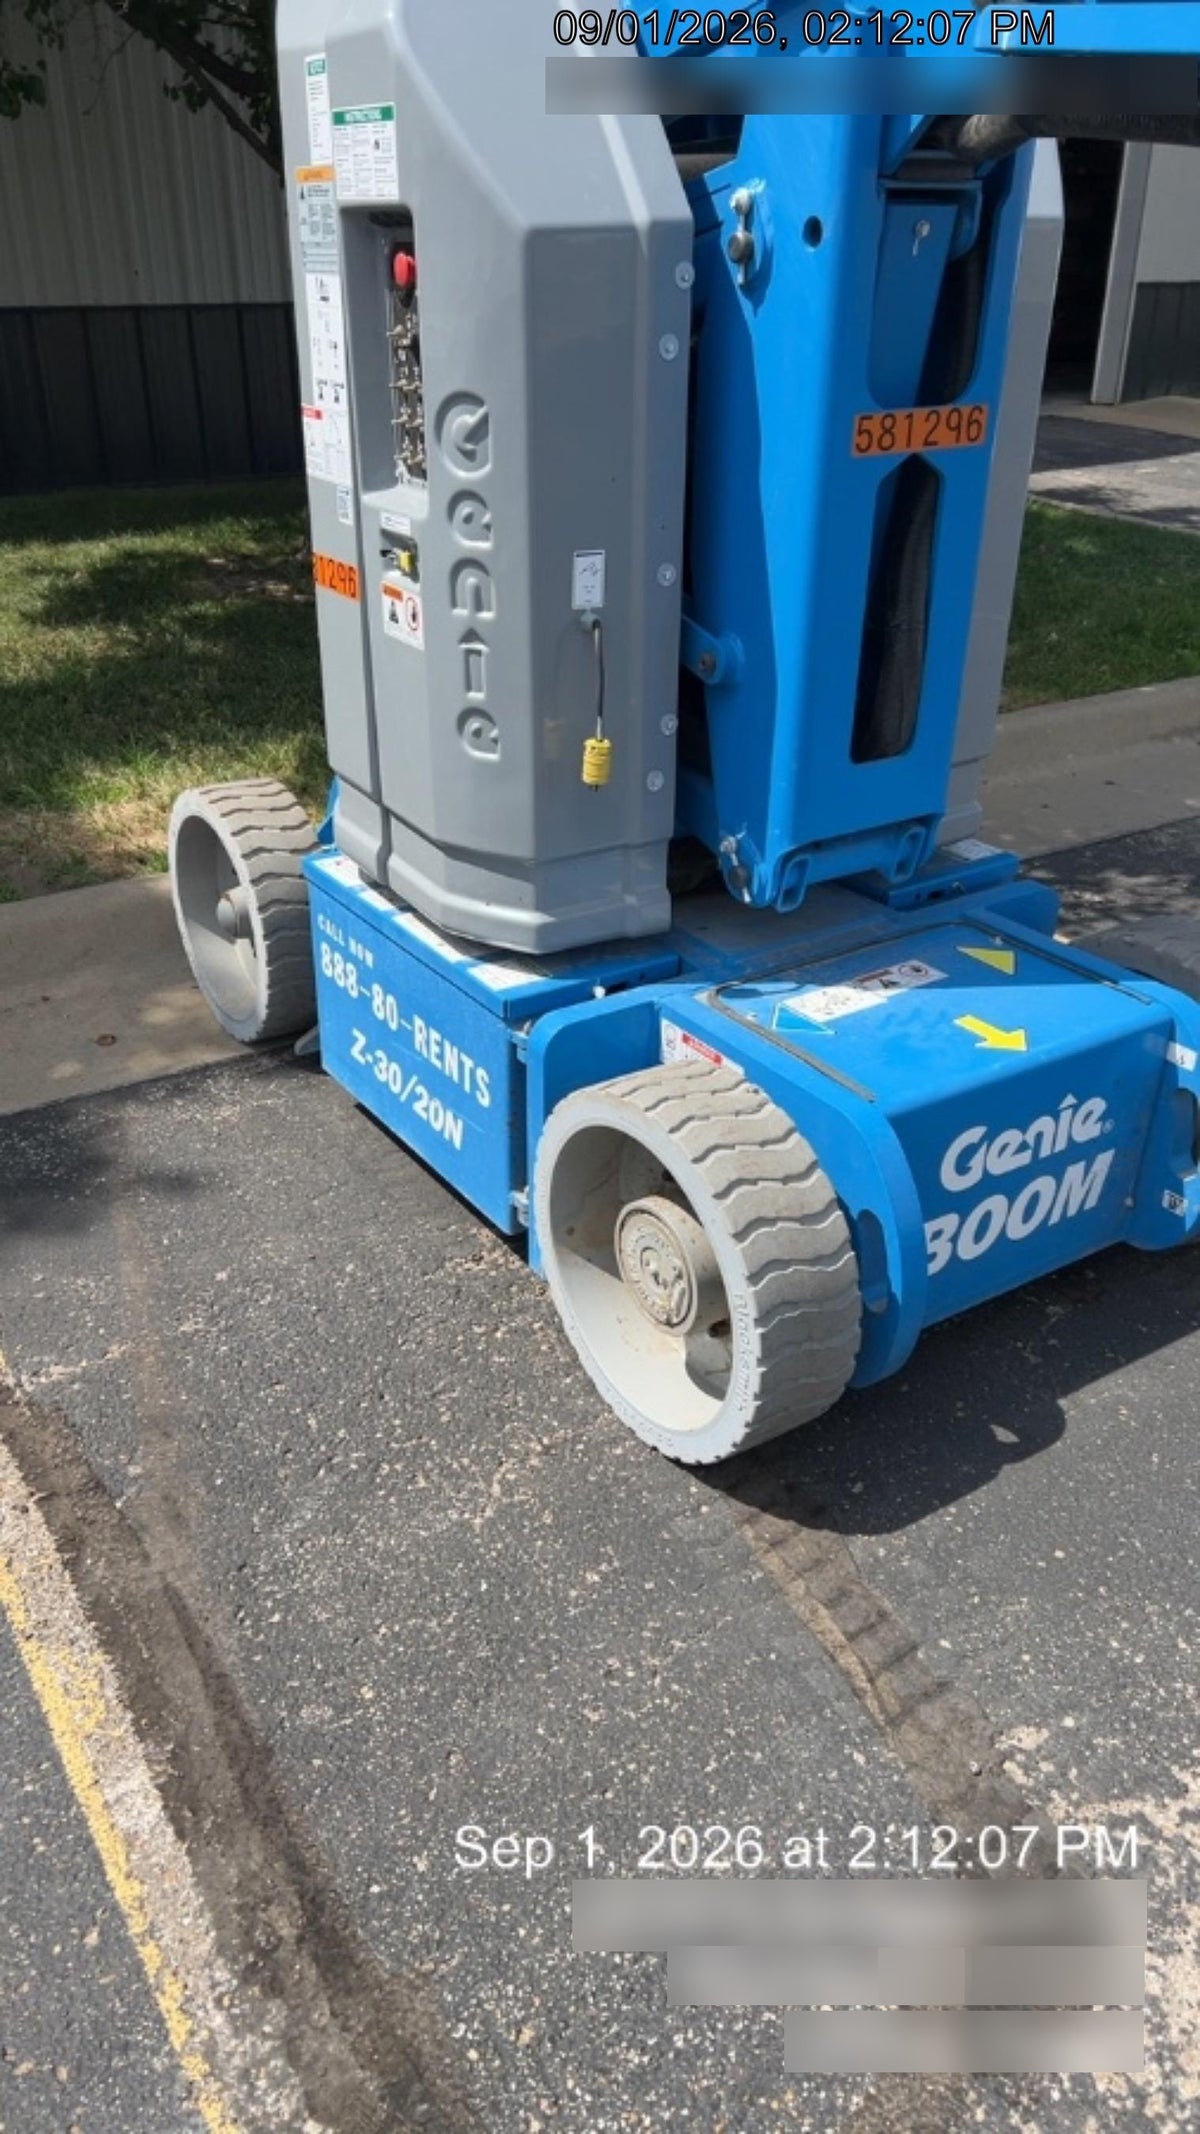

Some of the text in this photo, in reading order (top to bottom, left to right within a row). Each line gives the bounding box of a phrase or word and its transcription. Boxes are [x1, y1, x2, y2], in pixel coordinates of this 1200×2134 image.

[855, 405, 984, 454] 581296
[317, 913, 345, 947] CALL
[320, 940, 492, 1109] 888-80-RENTS
[350, 1027, 464, 1151] Z-30/20N
[924, 1148, 1116, 1276] BOOM
